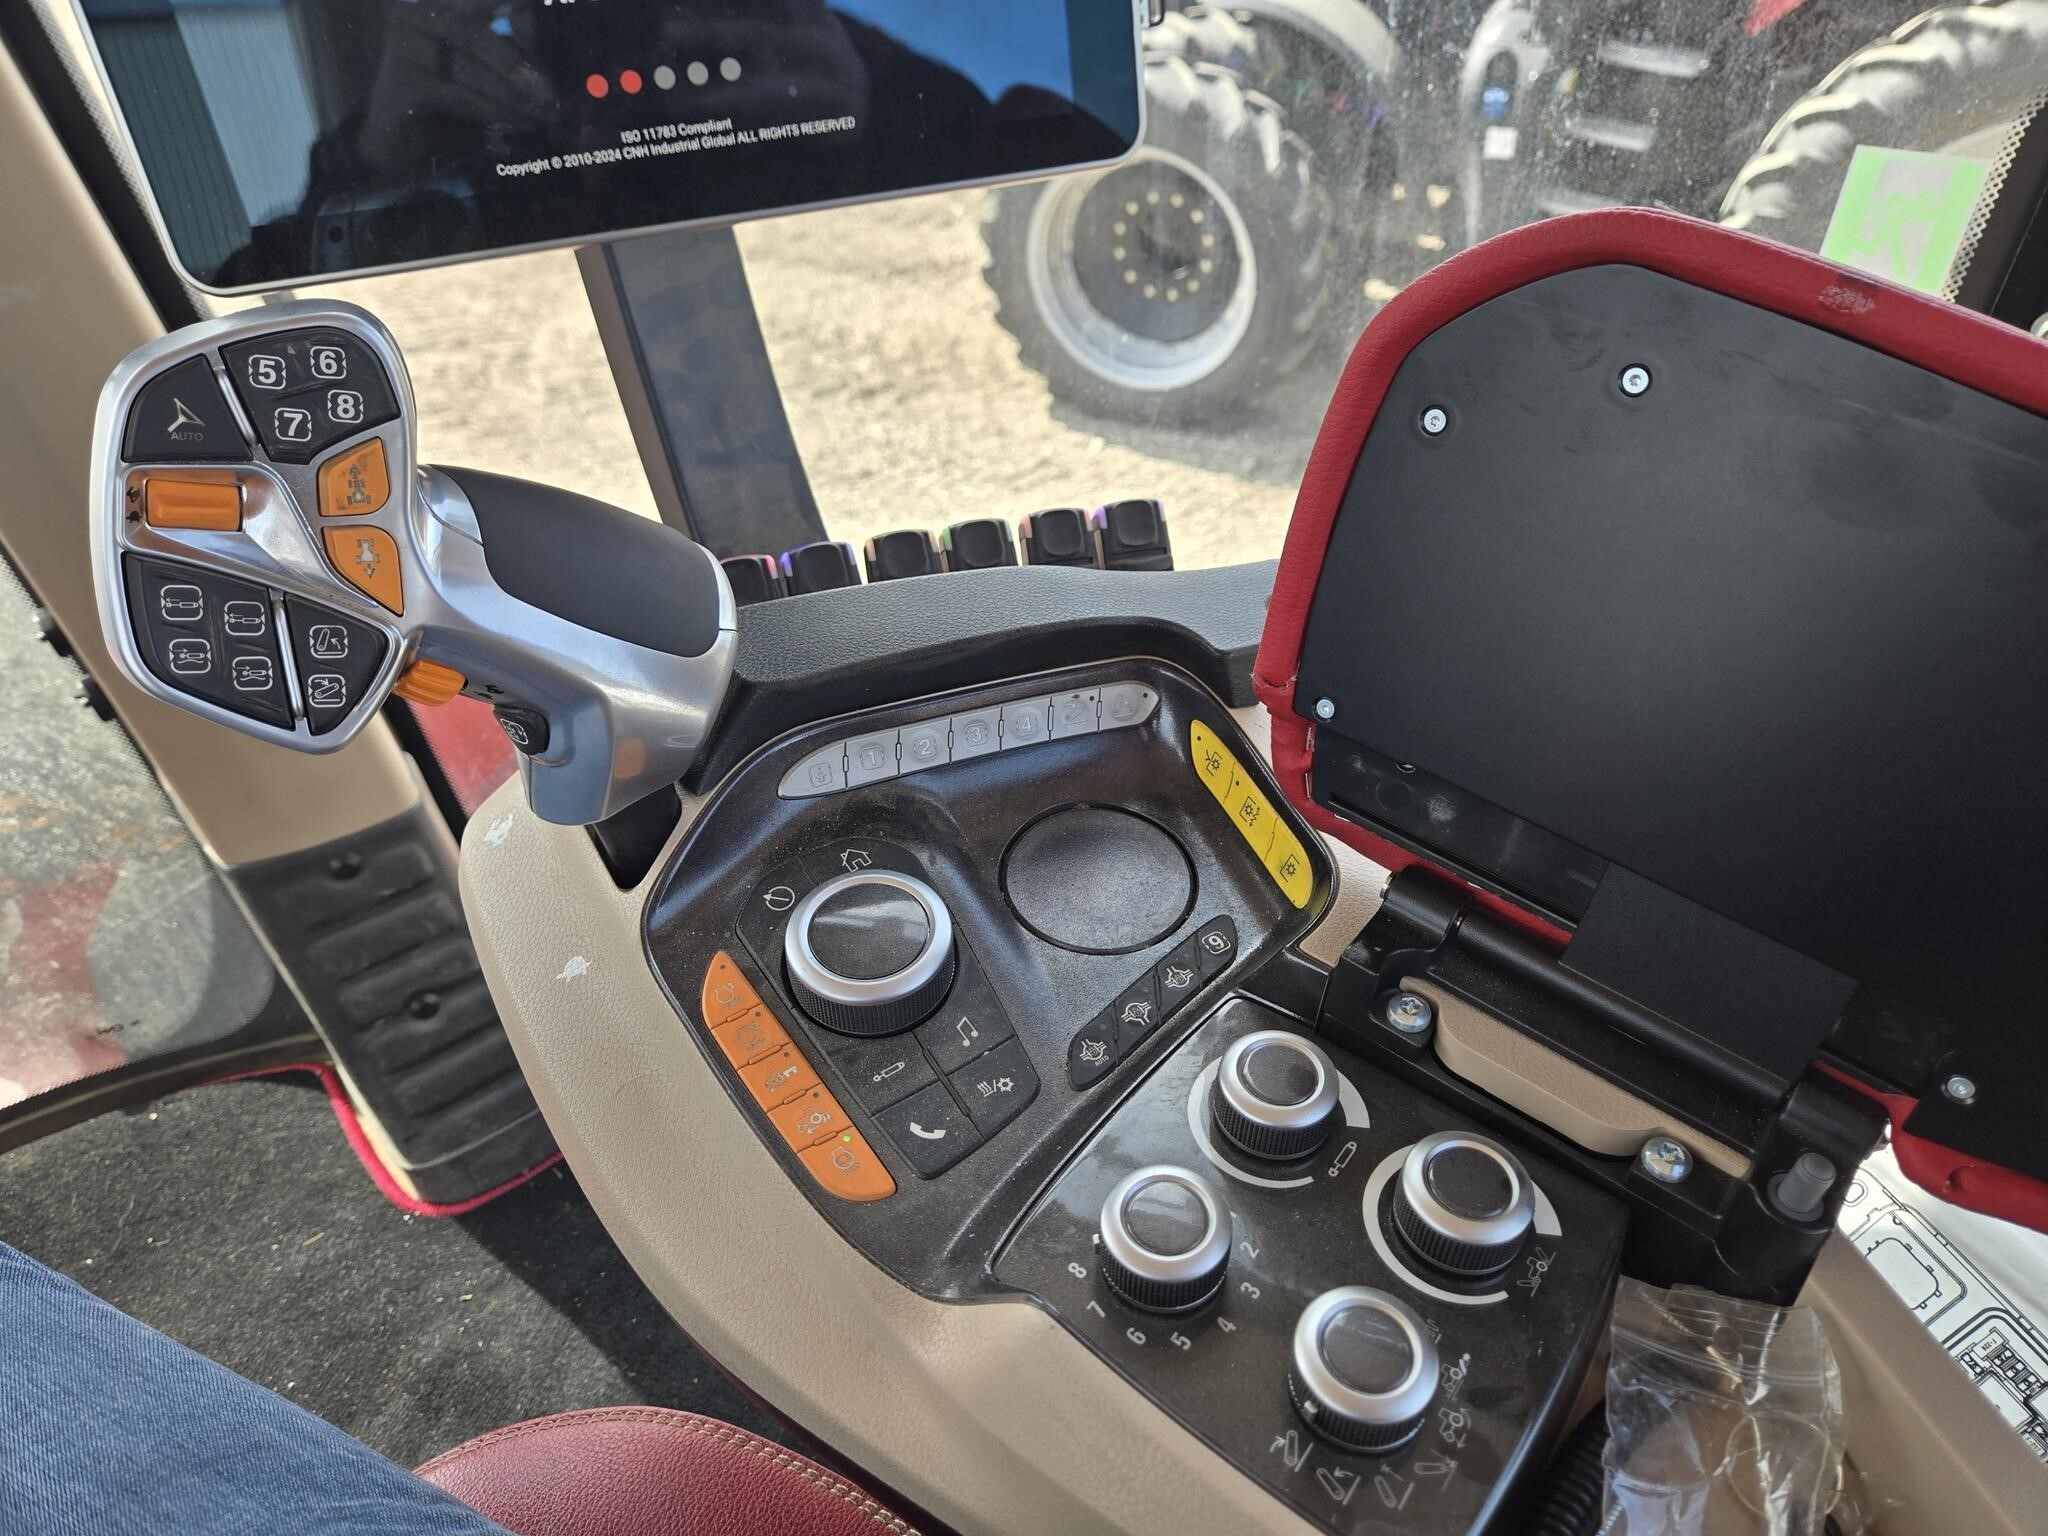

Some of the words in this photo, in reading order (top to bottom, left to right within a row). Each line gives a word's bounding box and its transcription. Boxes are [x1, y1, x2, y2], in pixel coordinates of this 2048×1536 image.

[620, 129, 642, 144] ISO
[677, 117, 733, 138] Compliant
[496, 158, 551, 177] Copyright
[562, 148, 622, 168] 2010-2024
[622, 144, 650, 160] CNH
[650, 137, 700, 156] Industrial
[701, 132, 736, 150] Global
[737, 129, 759, 145] ALL
[758, 123, 800, 142] RIGHTS
[800, 115, 856, 136] RESERVED
[258, 359, 277, 384] 5
[319, 351, 338, 374] 6
[283, 412, 303, 436] 7
[336, 394, 355, 419] 8
[171, 431, 204, 441] AUTO
[919, 738, 933, 756] 2
[970, 726, 983, 744] 3
[1021, 715, 1033, 732] 4
[1208, 935, 1225, 951] 9
[1094, 1054, 1110, 1067] AUTO
[1239, 1240, 1260, 1258] 2
[1067, 1262, 1088, 1279] 8
[1240, 1281, 1261, 1299] 3
[1086, 1300, 1106, 1318] 7
[1216, 1316, 1236, 1333] 4
[1126, 1327, 1146, 1345] 6
[1169, 1331, 1192, 1350] 5
